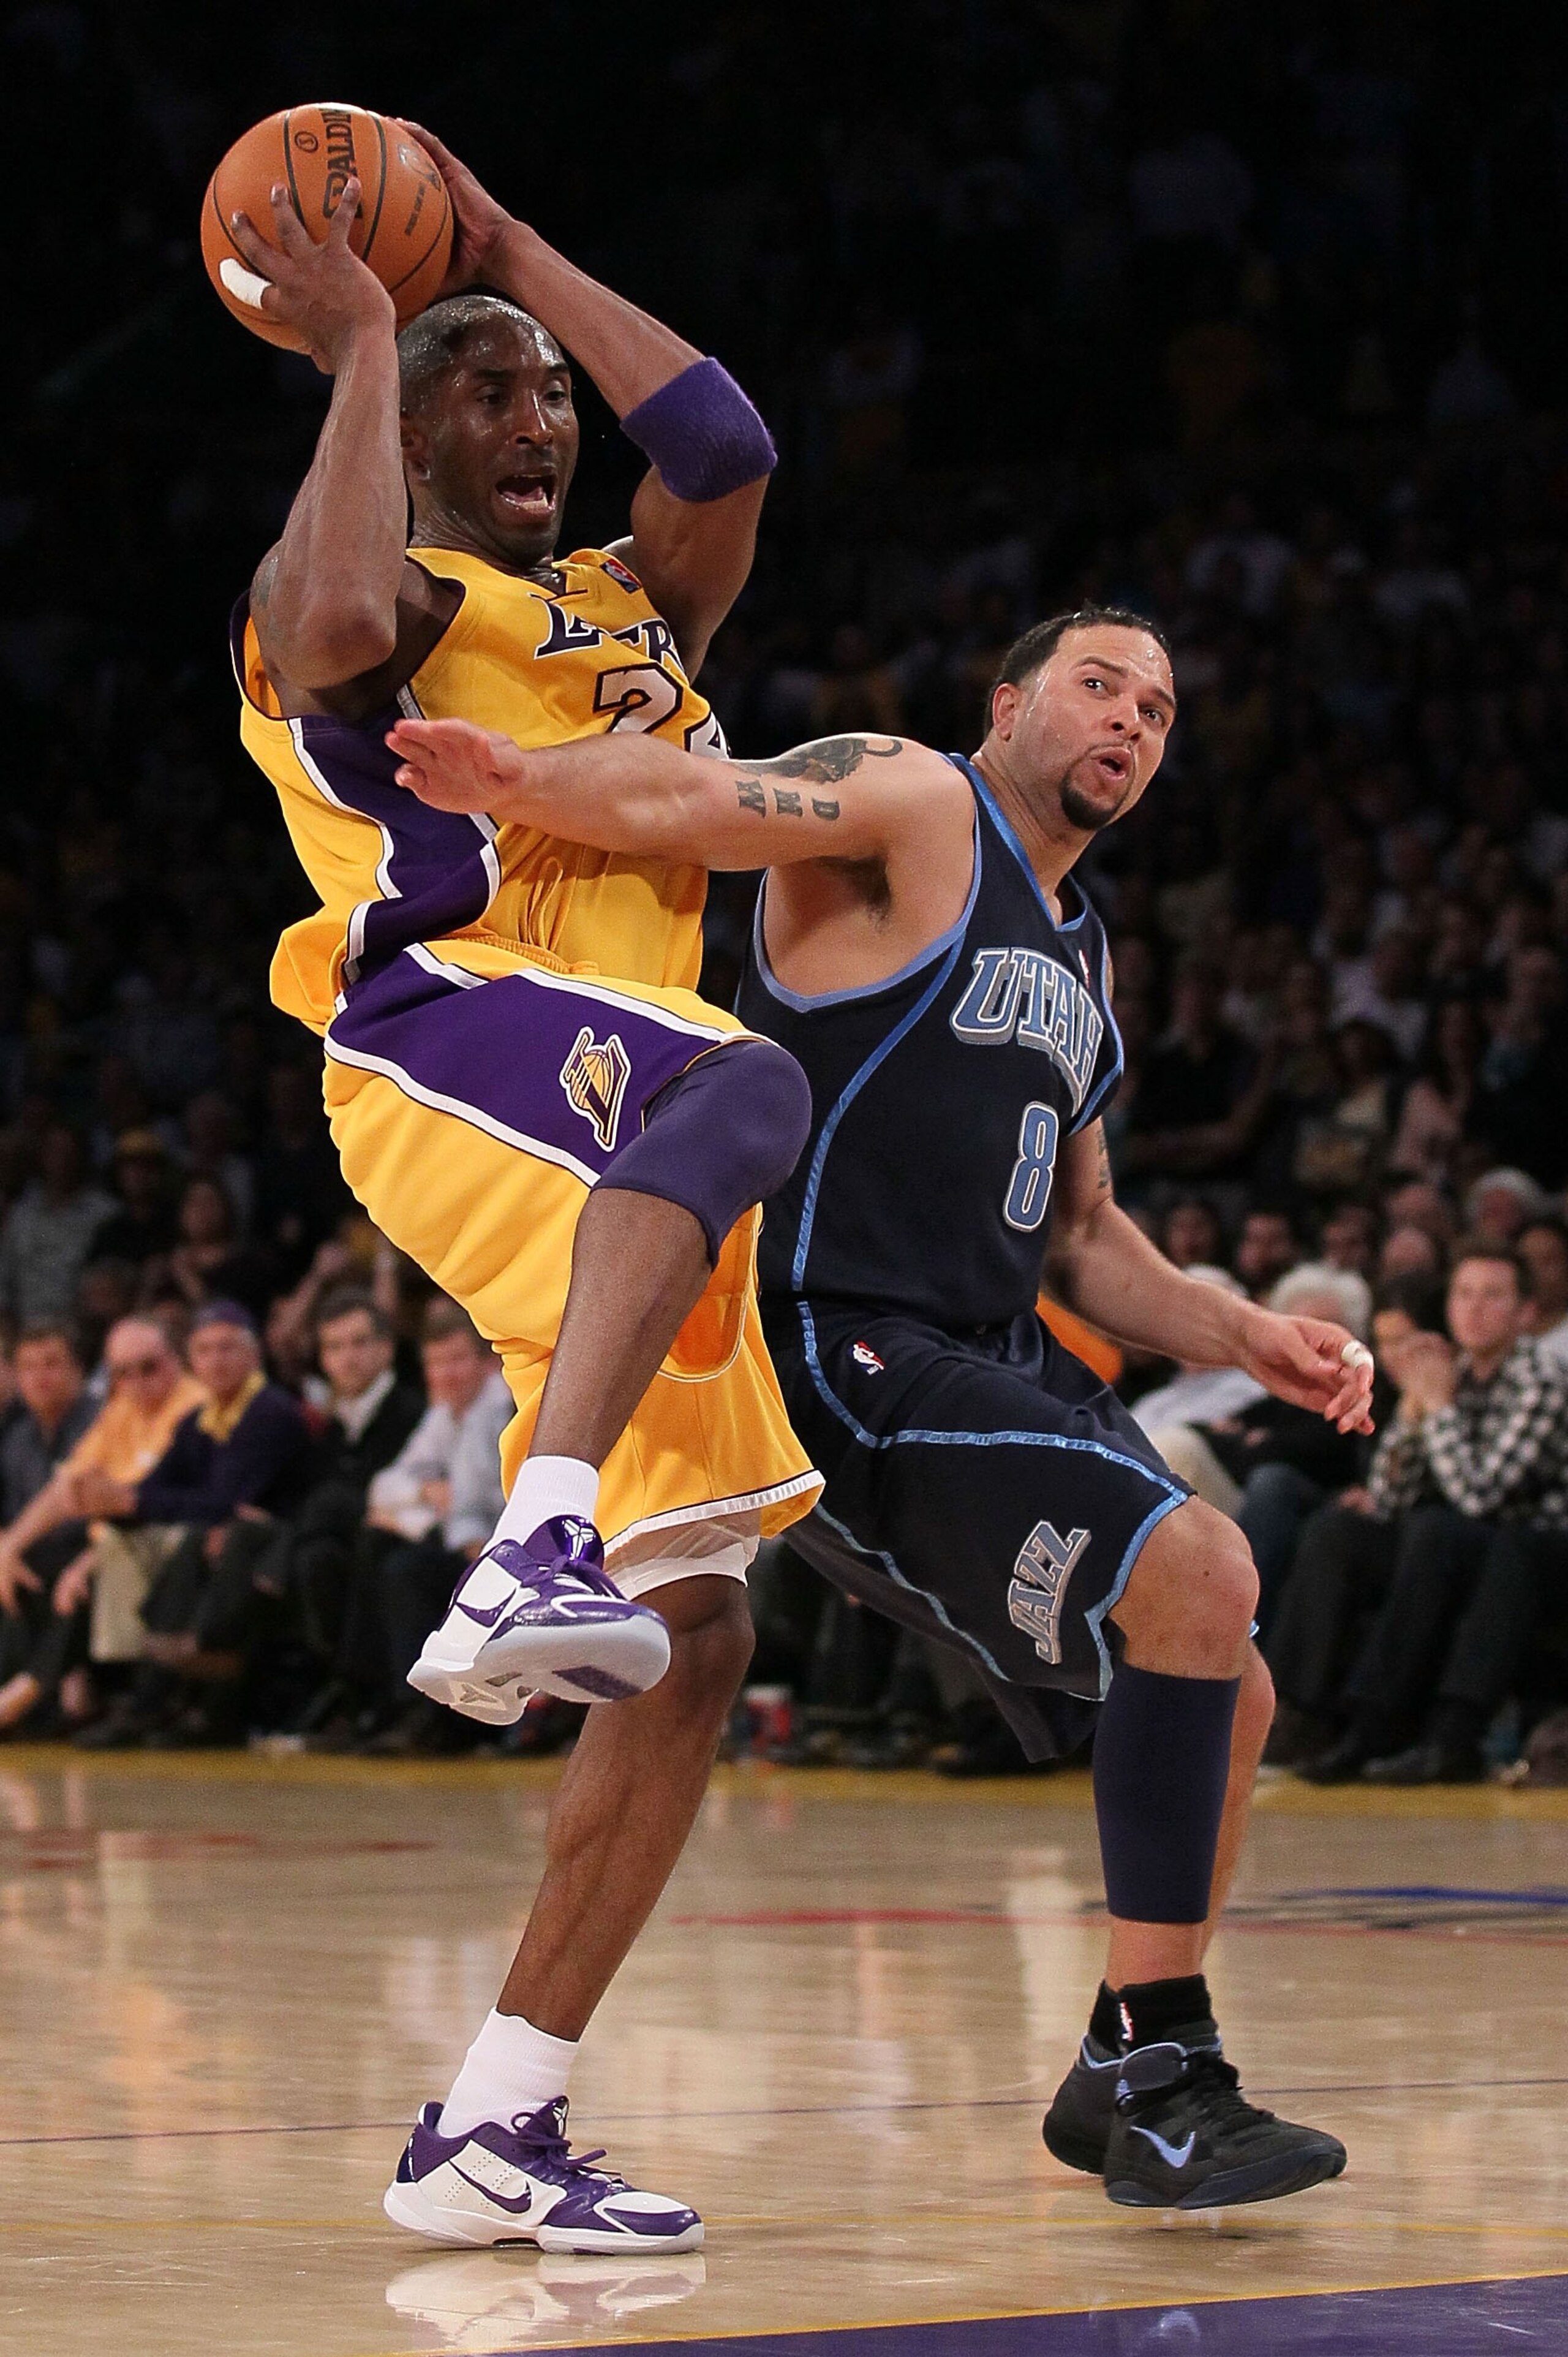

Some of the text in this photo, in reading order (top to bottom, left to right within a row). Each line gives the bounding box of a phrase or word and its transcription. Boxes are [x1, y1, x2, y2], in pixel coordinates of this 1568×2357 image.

[593, 662, 731, 760] 24
[949, 947, 1104, 1118] UTAH
[1003, 1101, 1059, 1233] 8
[1008, 1519, 1092, 1665] JAZZ
